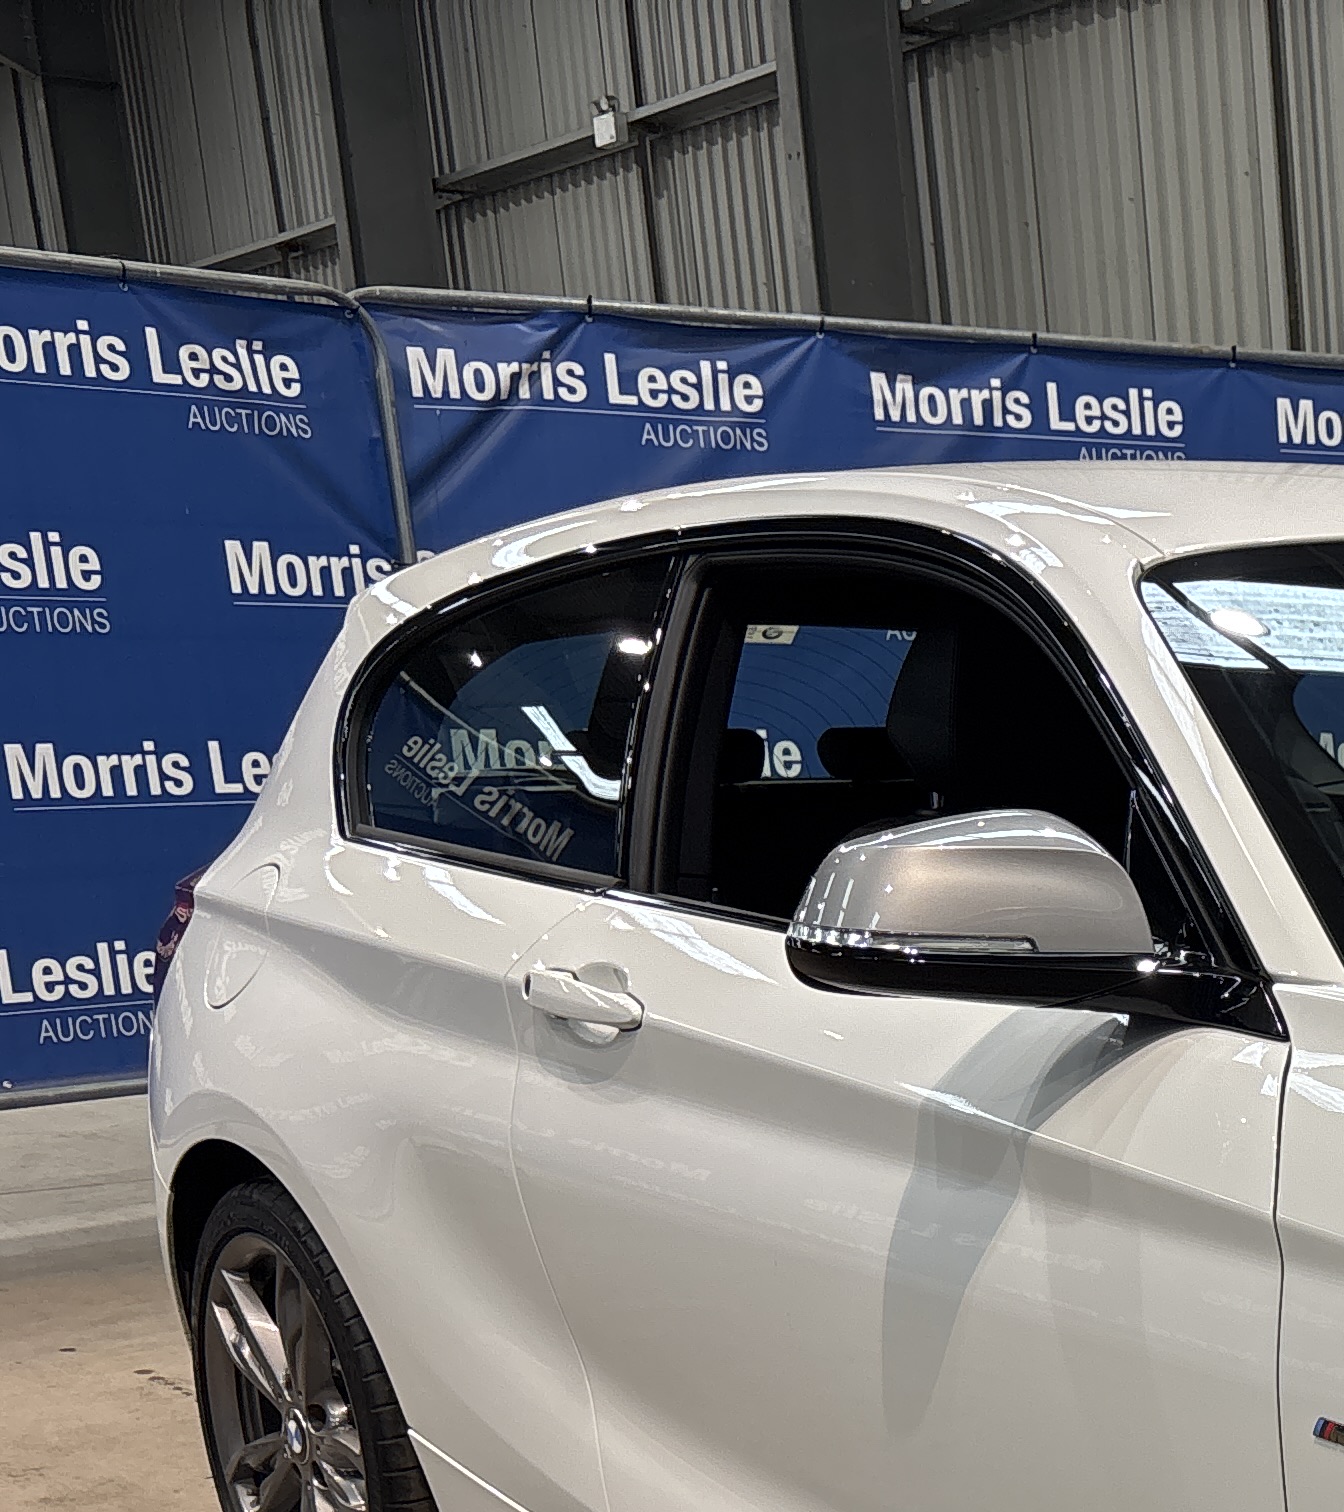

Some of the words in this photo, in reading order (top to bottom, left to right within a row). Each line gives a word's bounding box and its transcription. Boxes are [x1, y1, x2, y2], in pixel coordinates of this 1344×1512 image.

[0, 319, 131, 381] orris
[145, 327, 301, 397] Leslie
[406, 346, 587, 402] Morris
[604, 353, 763, 412] Leslie
[189, 405, 311, 438] AUCTIONS
[870, 371, 1032, 428] Morris
[1046, 382, 1183, 437] Leslie
[642, 423, 768, 451] AUCTIONS
[0, 531, 102, 590] slie
[4, 741, 193, 799] Morris
[39, 1010, 154, 1045] AUCTION
